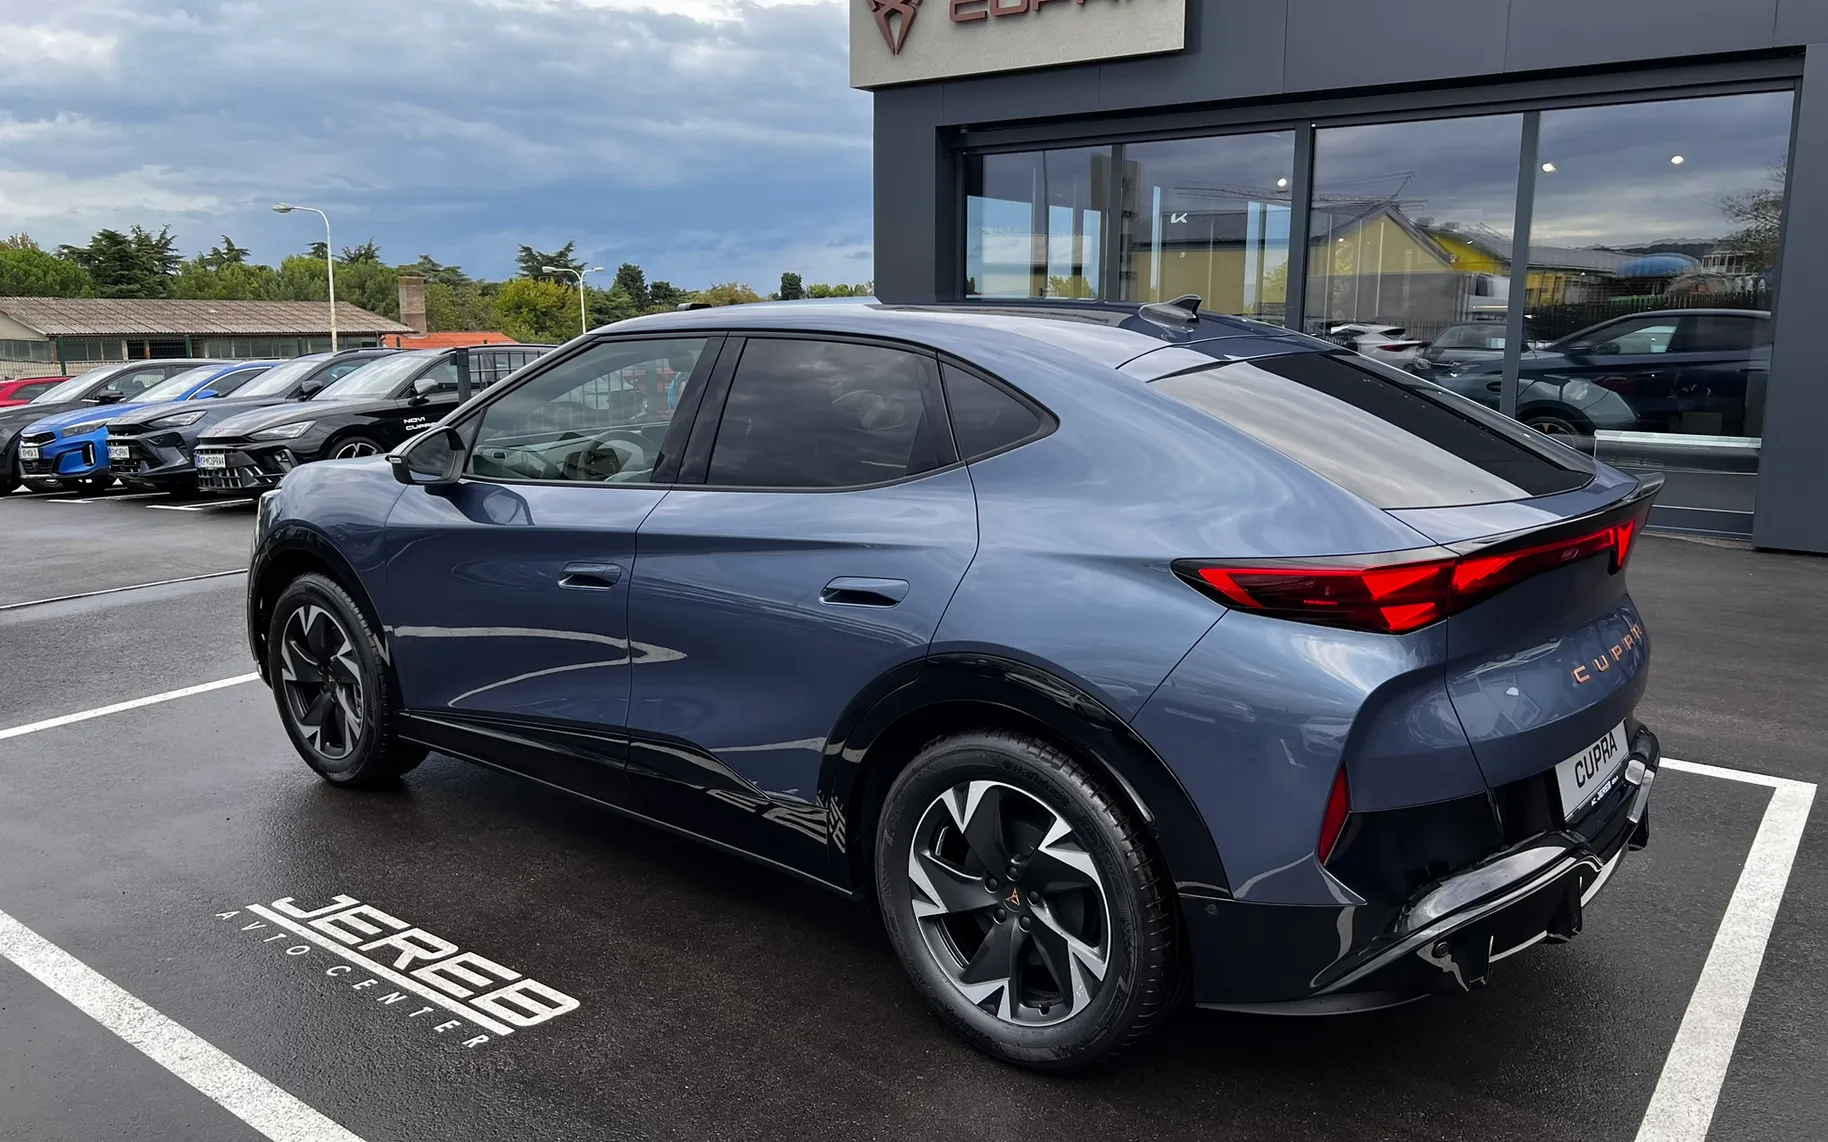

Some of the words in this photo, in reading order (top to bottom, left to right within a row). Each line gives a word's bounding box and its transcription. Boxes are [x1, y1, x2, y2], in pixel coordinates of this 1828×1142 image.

[1572, 622, 1643, 684] CUPRA
[1574, 730, 1618, 789] CUPRA
[215, 909, 312, 956] AVTO
[325, 964, 491, 1049] CENTER
[271, 893, 581, 1028] JEREB
